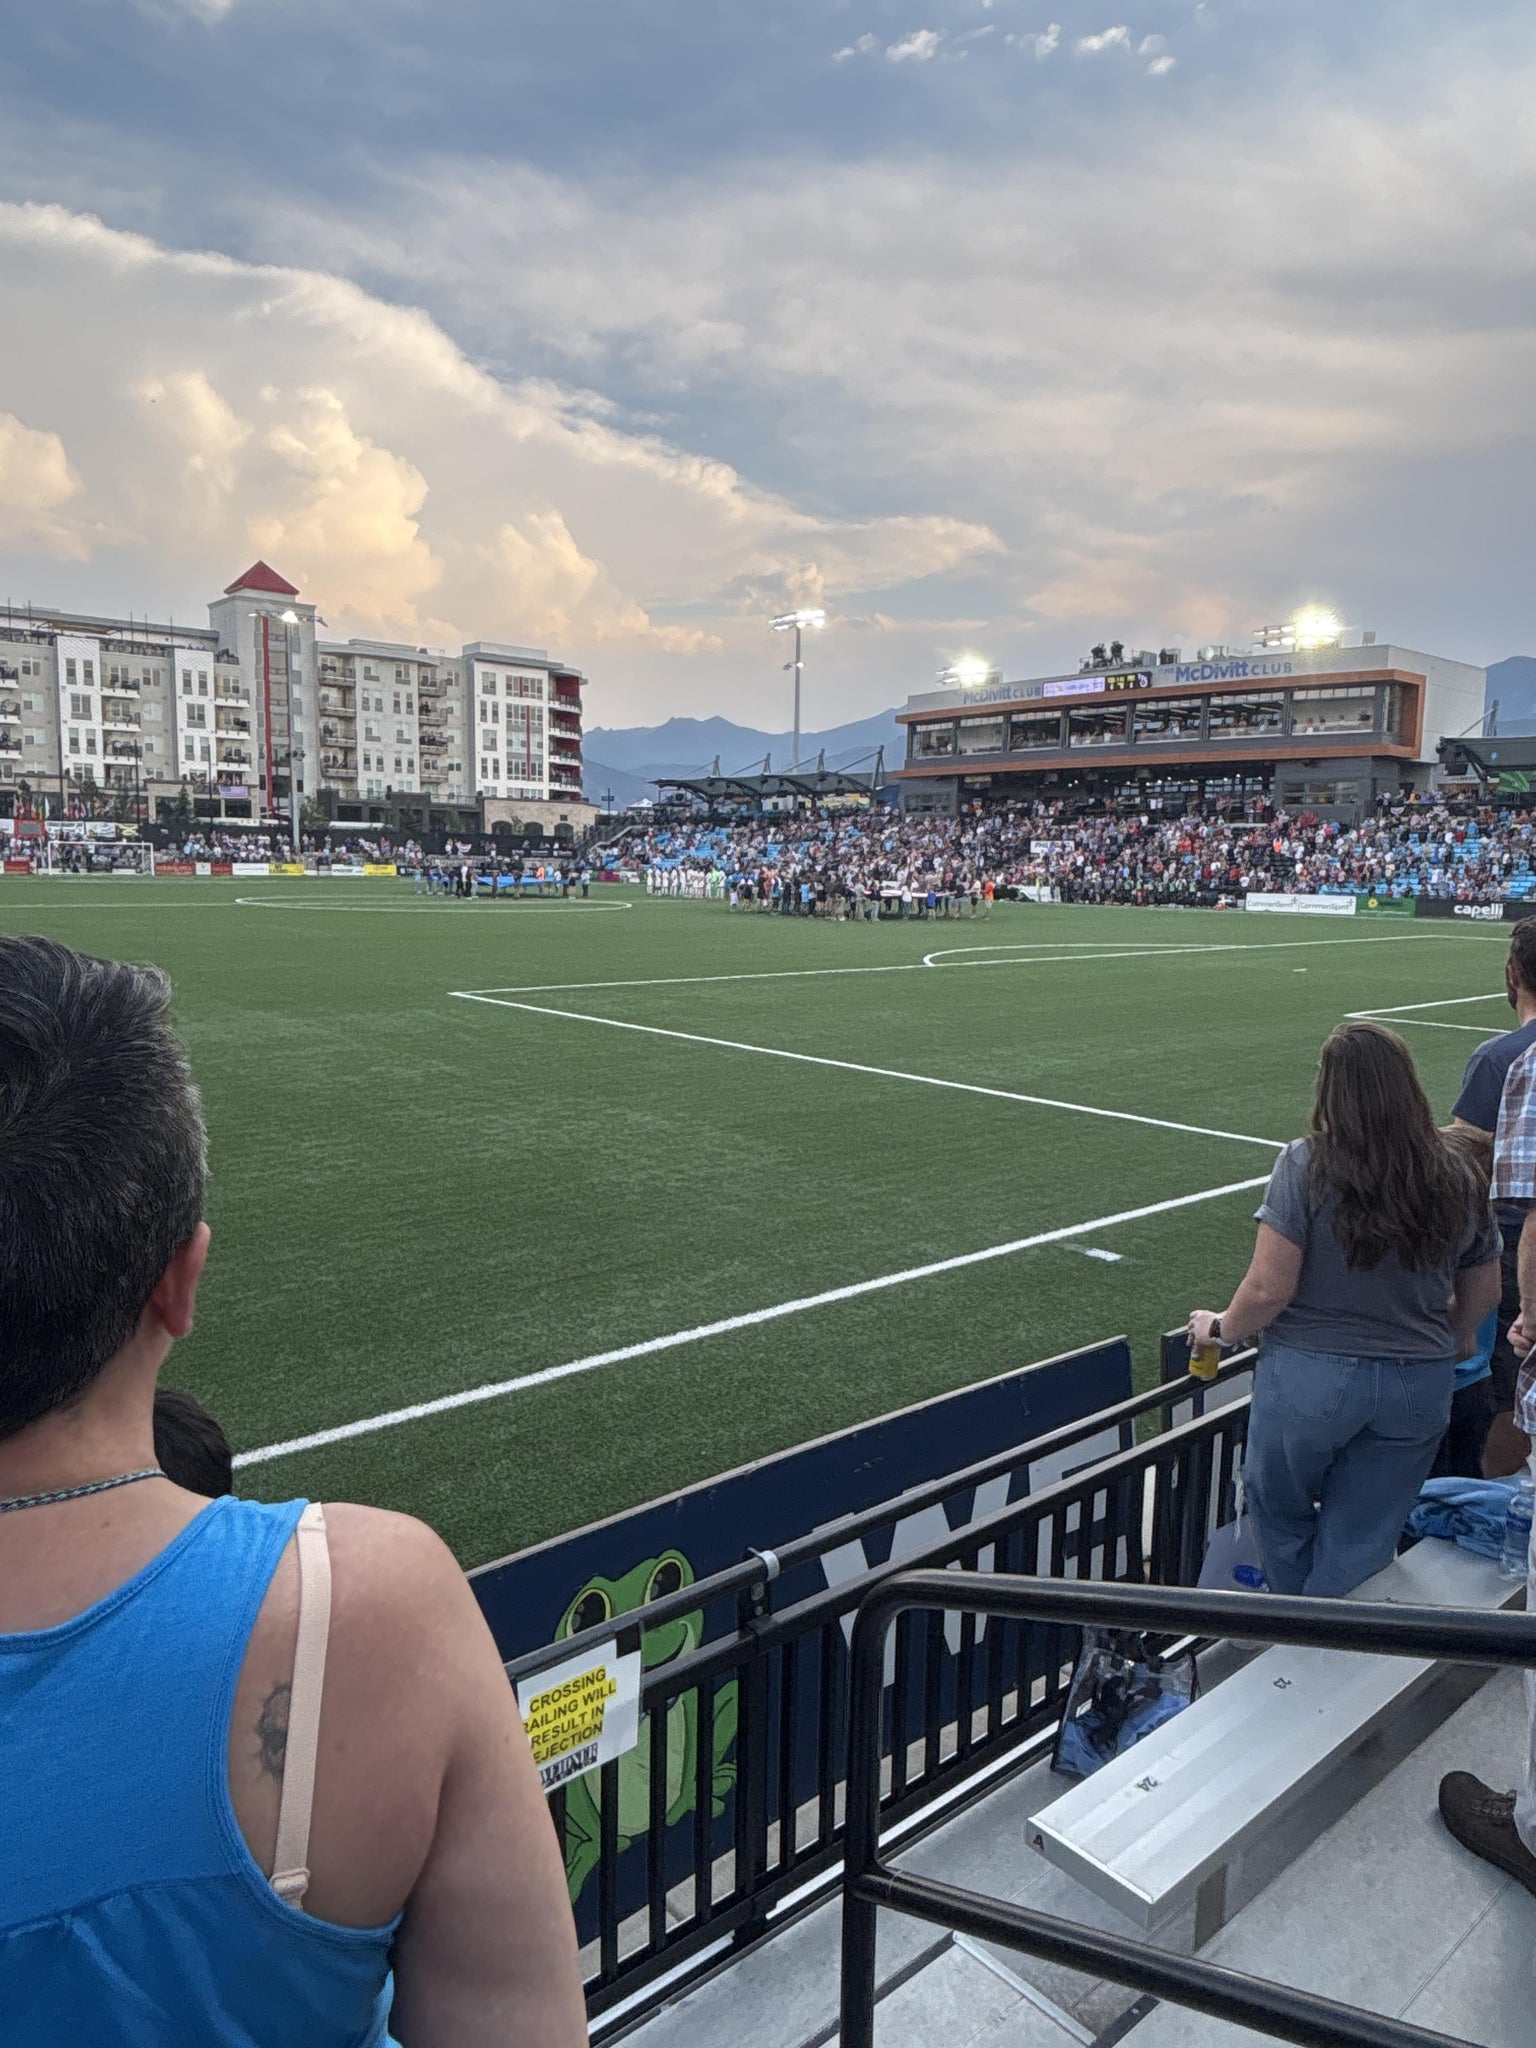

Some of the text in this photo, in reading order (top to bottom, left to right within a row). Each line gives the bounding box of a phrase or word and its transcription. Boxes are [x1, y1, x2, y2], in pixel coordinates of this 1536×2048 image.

[1175, 661, 1249, 682] McDivitt
[1251, 662, 1293, 676] CLUB
[963, 685, 1012, 704] McDivitt
[1012, 686, 1042, 698] CLUB
[1453, 902, 1504, 919] capelli
[530, 1667, 606, 1713] CROSSING
[582, 1681, 617, 1706] WILL
[531, 1702, 605, 1749] RESULT IN
[533, 1720, 603, 1763] EJECTION
[1134, 1776, 1159, 1792] 24
[1033, 1834, 1045, 1850] A
